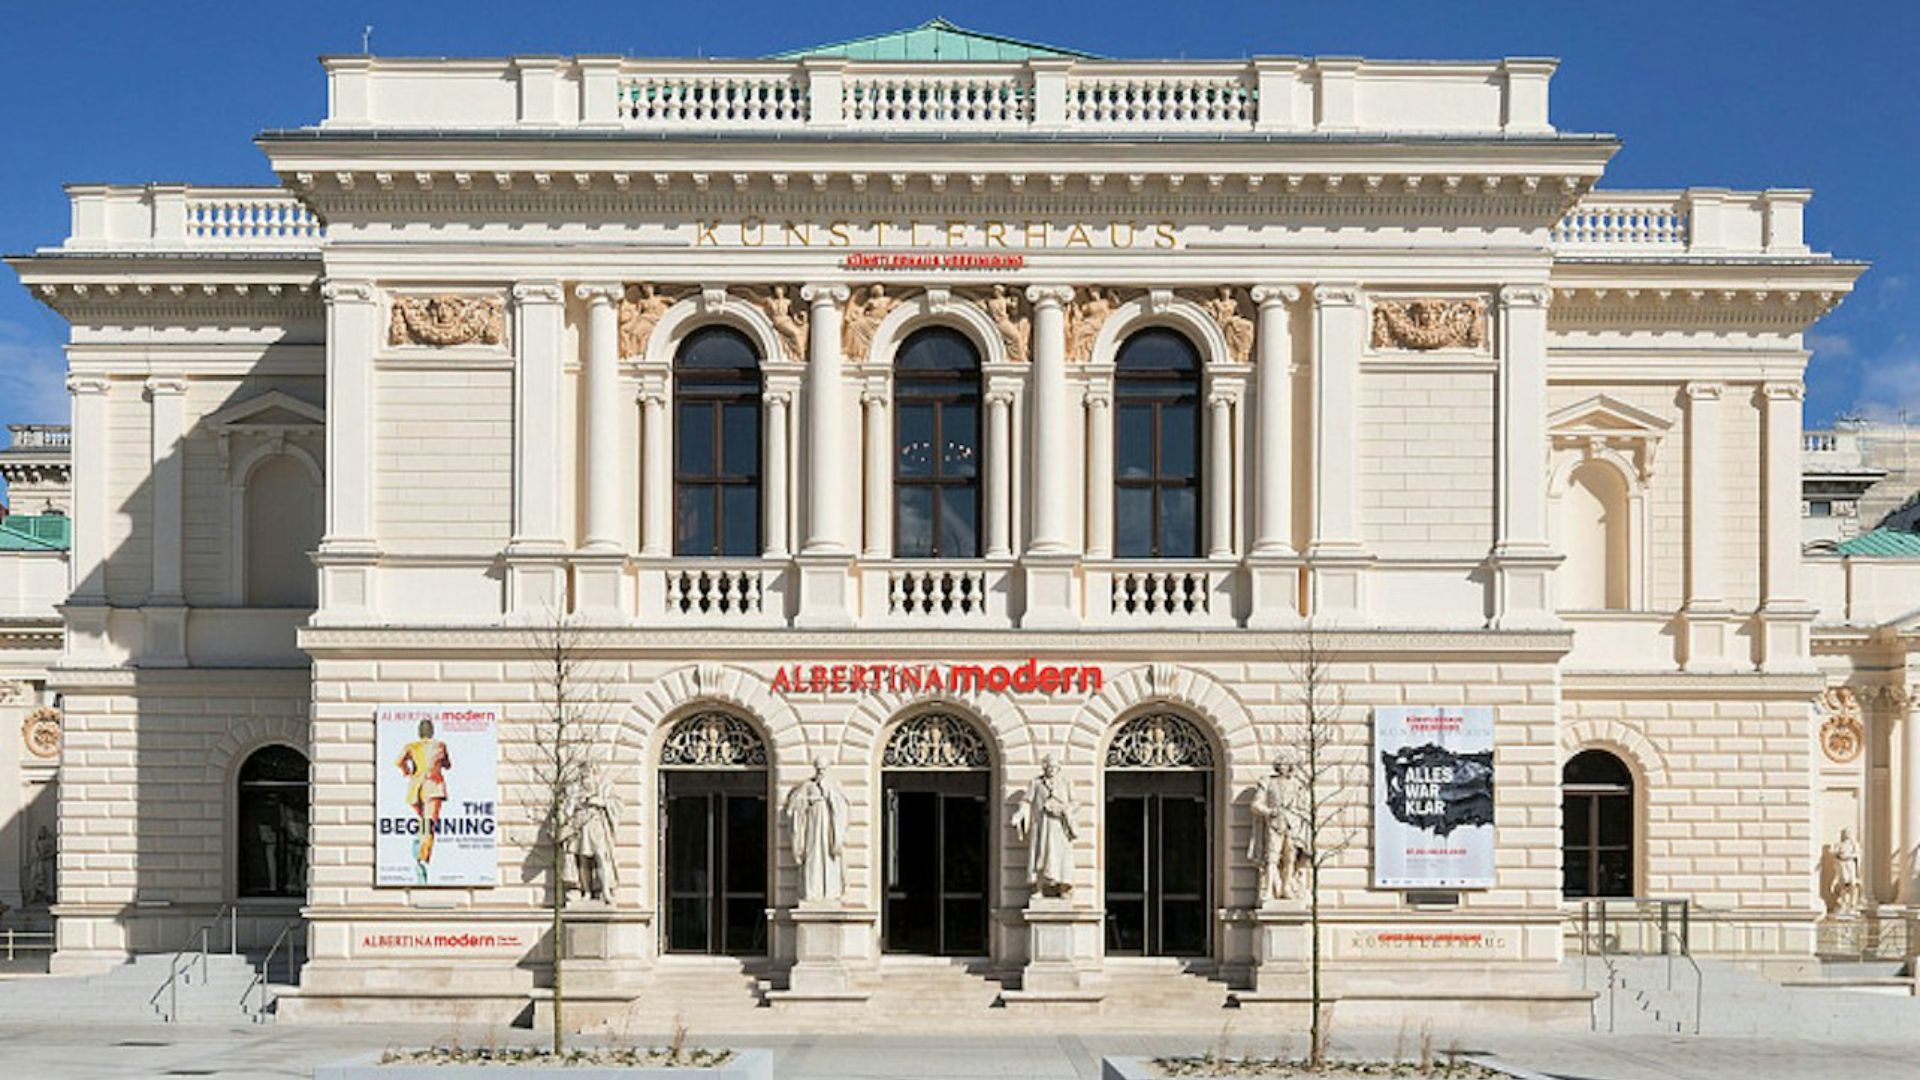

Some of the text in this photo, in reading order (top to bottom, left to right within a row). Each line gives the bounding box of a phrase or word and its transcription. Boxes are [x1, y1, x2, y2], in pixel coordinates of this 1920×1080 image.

[696, 216, 1177, 247] KÜNSTLERHAUS
[770, 657, 1103, 693] ALBERTINA modern
[1404, 767, 1453, 784] ALLES
[1405, 784, 1441, 799] WAR
[462, 802, 494, 815] THE
[1405, 800, 1446, 816] KLAR
[379, 818, 495, 836] BEGINNING
[362, 935, 433, 947] ALBERTINA
[433, 933, 496, 947] modern
